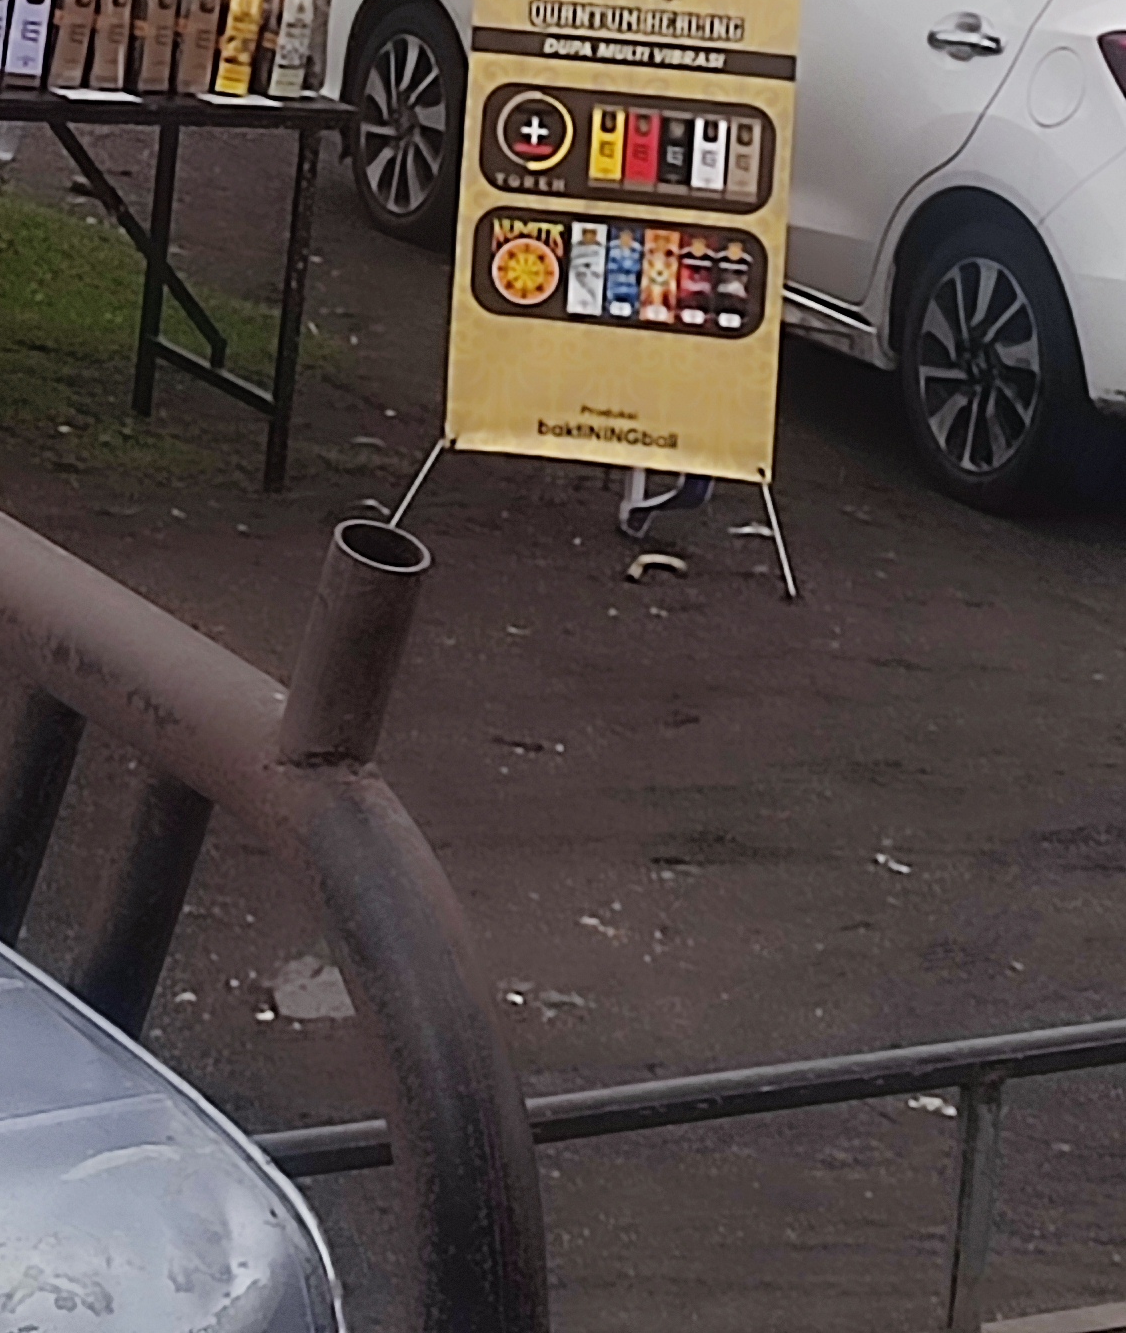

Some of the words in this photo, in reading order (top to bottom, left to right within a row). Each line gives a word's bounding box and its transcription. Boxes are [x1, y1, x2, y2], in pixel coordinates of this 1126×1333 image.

[643, 7, 746, 42] HEALING
[543, 36, 594, 58] DUPA
[596, 41, 651, 62] MULTI
[652, 46, 727, 70] VIBRASI
